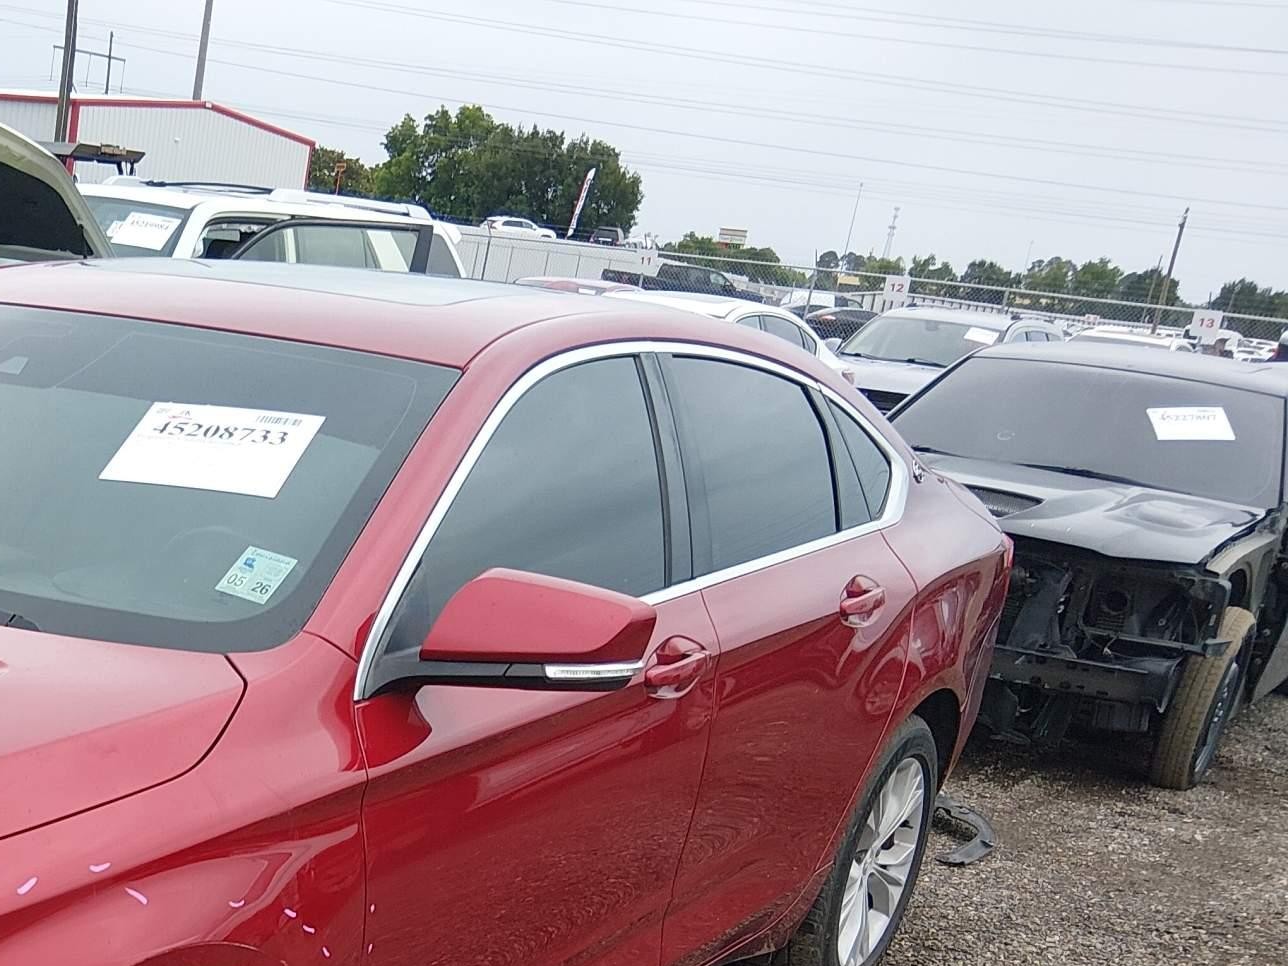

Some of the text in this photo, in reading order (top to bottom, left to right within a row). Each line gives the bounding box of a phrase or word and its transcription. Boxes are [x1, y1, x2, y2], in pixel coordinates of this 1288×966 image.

[891, 282, 905, 293] 12
[1199, 317, 1216, 329] 13
[153, 420, 289, 446] 45208733
[226, 573, 272, 596] 05 26
